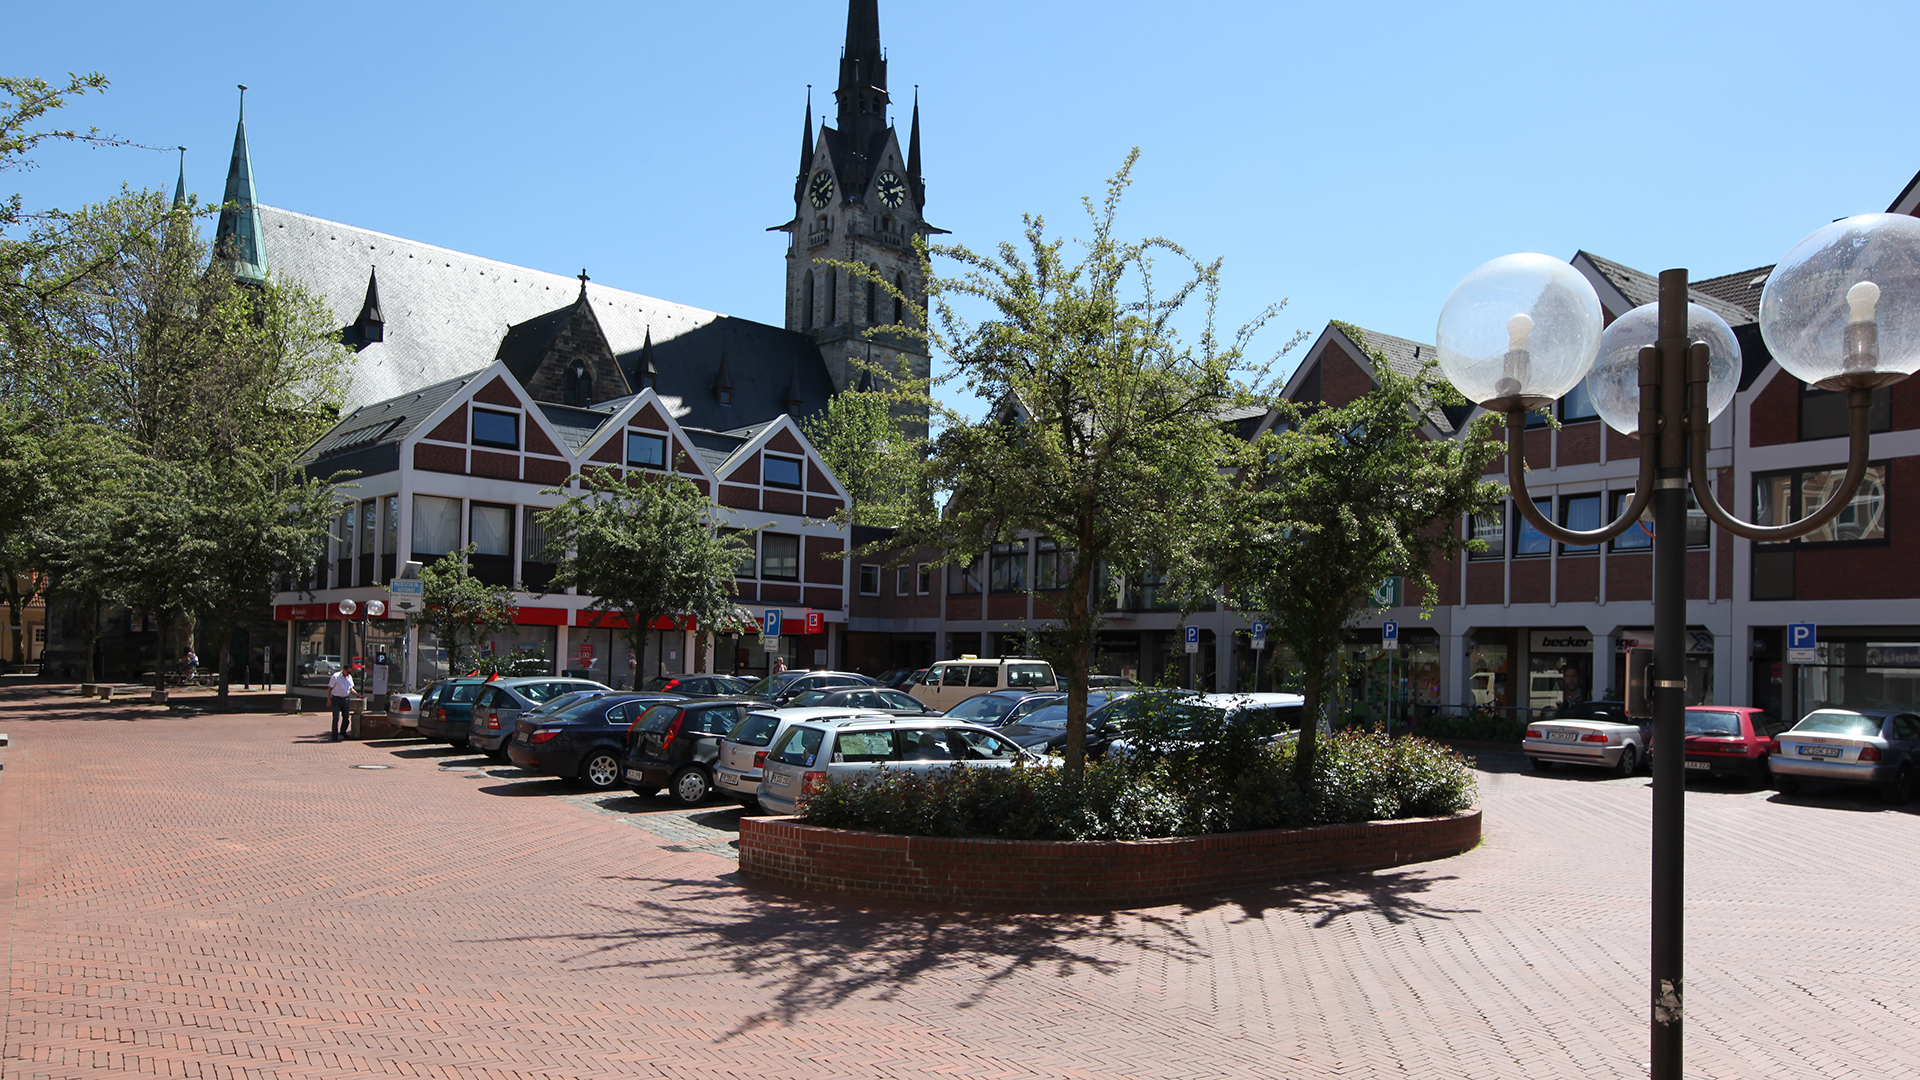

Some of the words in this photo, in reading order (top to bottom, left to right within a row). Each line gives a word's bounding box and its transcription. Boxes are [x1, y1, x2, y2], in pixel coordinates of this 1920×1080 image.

[767, 612, 777, 633] P
[1188, 628, 1196, 641] P
[1386, 623, 1395, 637] P
[1794, 626, 1809, 646] P
[1542, 636, 1593, 647] becker
